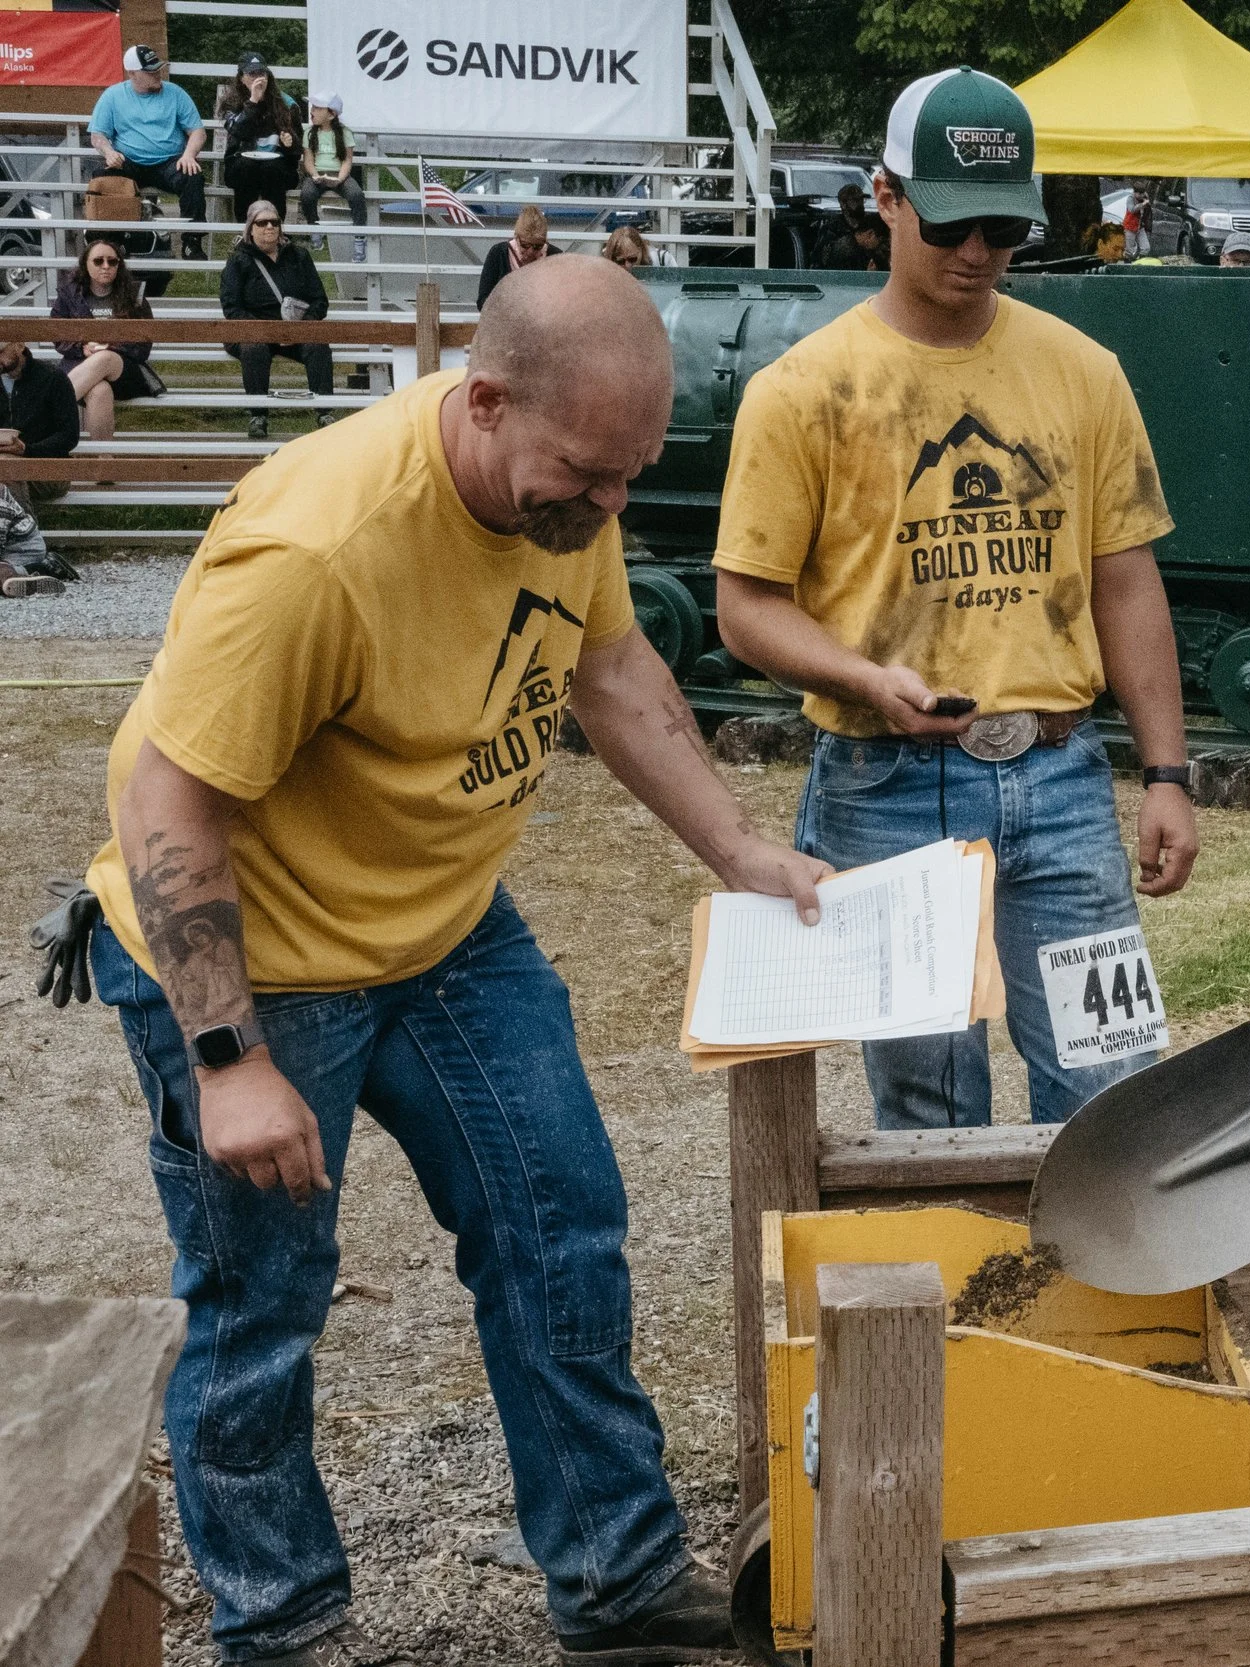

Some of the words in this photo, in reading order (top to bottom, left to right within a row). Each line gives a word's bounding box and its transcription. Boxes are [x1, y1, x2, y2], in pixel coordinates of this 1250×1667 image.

[4, 63, 35, 72] Alaska
[426, 38, 641, 85] SANDVIK
[953, 131, 1002, 143] SCHOOL
[1005, 133, 1016, 144] OF
[979, 146, 1020, 159] MINES
[896, 510, 1067, 544] JUNEAU
[911, 541, 978, 585] GOLD
[987, 537, 1053, 576] RUSH
[954, 583, 1022, 612] days
[919, 869, 932, 899] Juneau
[923, 900, 935, 922] Gold
[912, 914, 922, 938] Score
[925, 923, 936, 945] Rush
[913, 939, 924, 963] Sheet
[1049, 946, 1087, 972] JUNEAU
[1088, 940, 1117, 961] GOLD
[1119, 935, 1138, 954] RUSH
[1082, 957, 1156, 1026] 444
[1067, 1034, 1102, 1051] ANNUAL
[1104, 1028, 1136, 1044] MINING
[1138, 1024, 1147, 1035] &
[1101, 1031, 1158, 1055] COMPETITION
